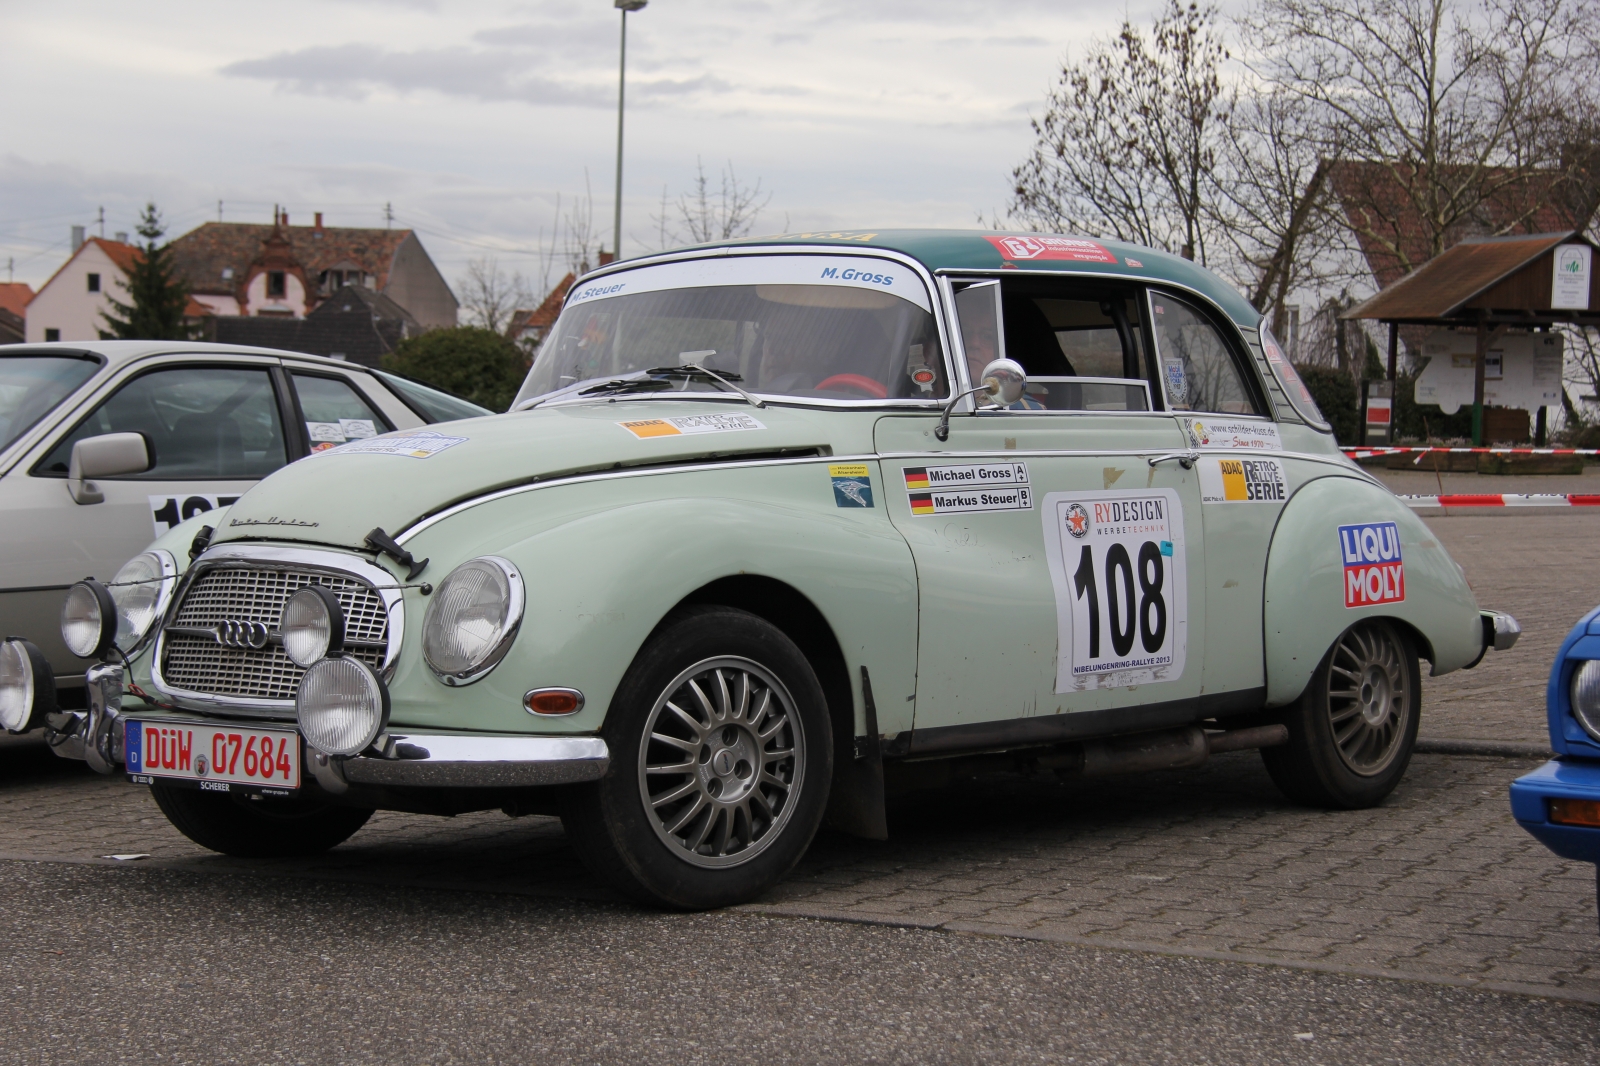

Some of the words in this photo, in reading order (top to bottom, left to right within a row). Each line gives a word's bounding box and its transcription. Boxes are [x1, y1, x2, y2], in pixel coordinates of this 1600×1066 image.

[820, 267, 894, 286] M.Gross
[571, 283, 626, 303] M.Steuer
[624, 419, 665, 429] ADAC
[1232, 436, 1250, 448] Since
[1250, 439, 1265, 448] 1970
[929, 468, 976, 482] Michael
[978, 468, 1012, 480] Gross
[1016, 465, 1025, 475] A
[1220, 461, 1243, 475] ADAC
[1020, 490, 1028, 500] B
[1247, 482, 1286, 501] SERIE
[934, 494, 978, 508] Markus
[980, 493, 1018, 506] Steuer
[1094, 501, 1163, 523] RYDESIGN
[1097, 525, 1165, 535] WERBETECHNIK
[1342, 527, 1399, 562] LIQUI
[1347, 565, 1401, 603] MOLY
[1073, 540, 1167, 659] 108
[131, 751, 138, 763] D
[212, 732, 291, 780] 07684
[200, 780, 230, 792] SCHERER
